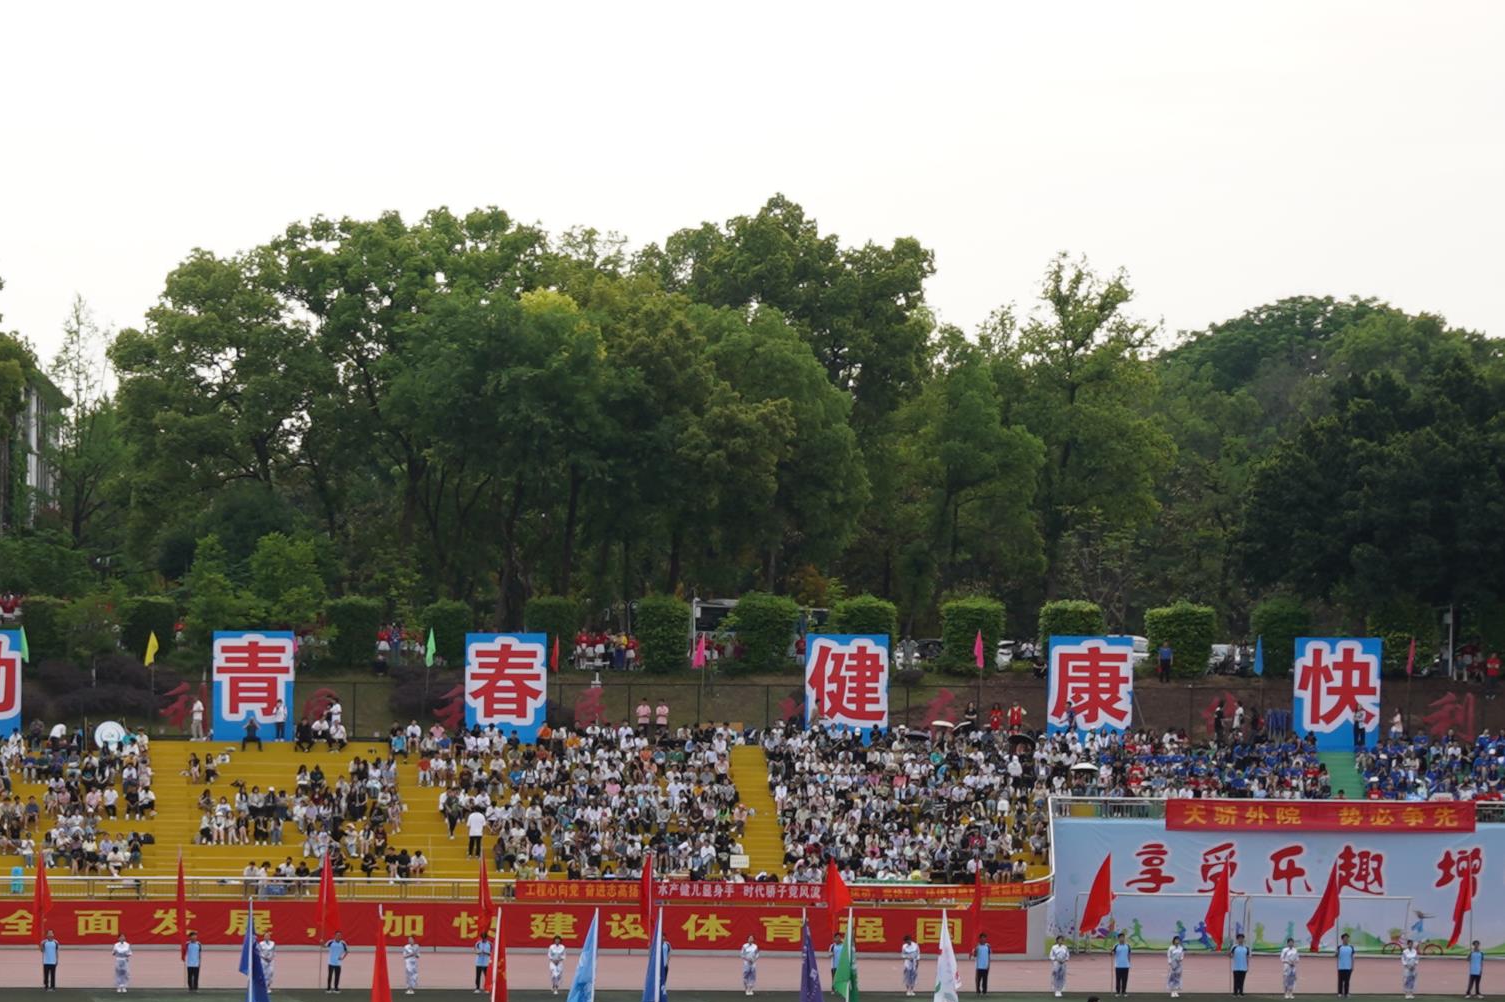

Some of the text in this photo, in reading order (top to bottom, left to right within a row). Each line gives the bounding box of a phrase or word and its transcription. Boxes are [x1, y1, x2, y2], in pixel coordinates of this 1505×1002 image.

[216, 641, 290, 716] 青
[470, 644, 541, 718] 春
[808, 645, 885, 721] 健
[1051, 647, 1129, 723] 康
[1298, 648, 1376, 725] 快
[1183, 805, 1460, 829] 天骄外院 势必争先
[1126, 842, 1385, 896] 享受乐趣
